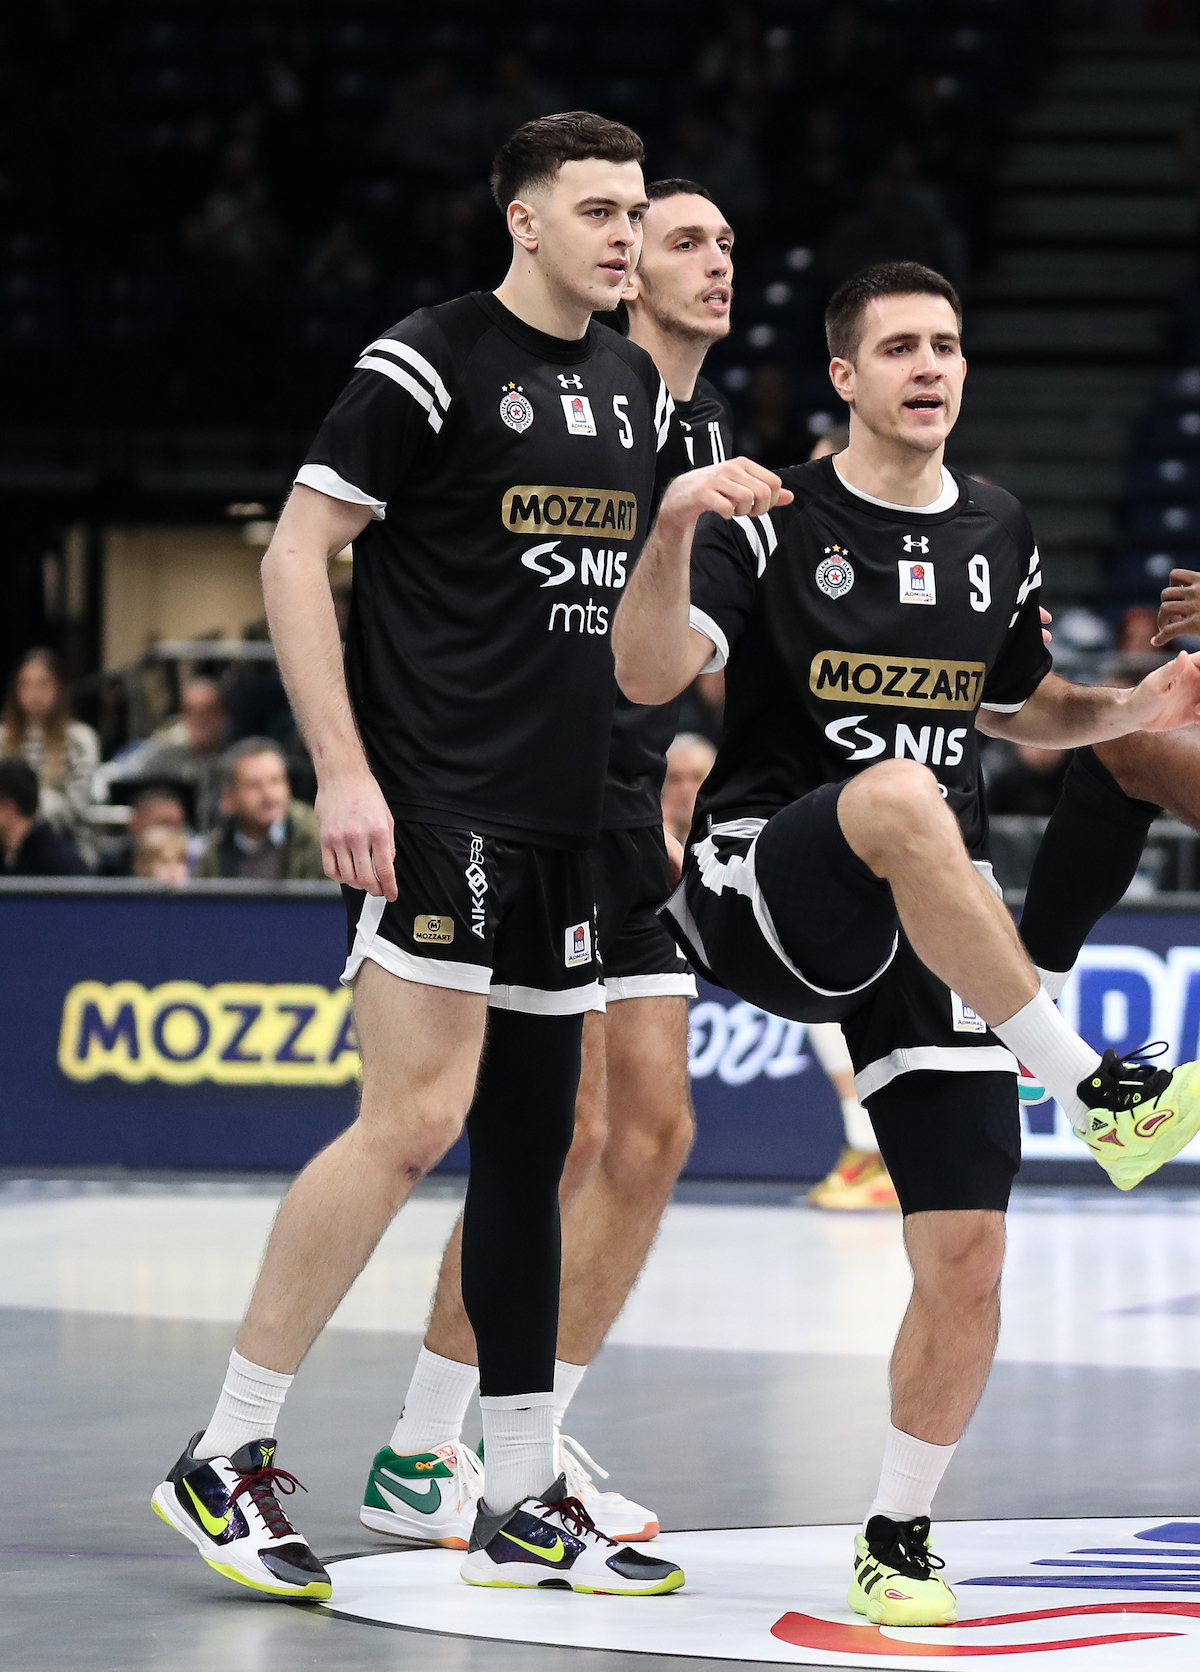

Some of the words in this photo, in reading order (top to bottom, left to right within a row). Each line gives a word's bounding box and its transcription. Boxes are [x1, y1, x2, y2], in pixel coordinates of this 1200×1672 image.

[613, 395, 634, 449] 5
[509, 494, 635, 532] MOZZART
[581, 548, 627, 588] NIS
[968, 554, 991, 612] 9
[549, 598, 609, 635] mts
[816, 658, 983, 702] MOZZART
[895, 723, 967, 766] NIS
[416, 932, 452, 941] MOZZART
[472, 896, 485, 939] AIK
